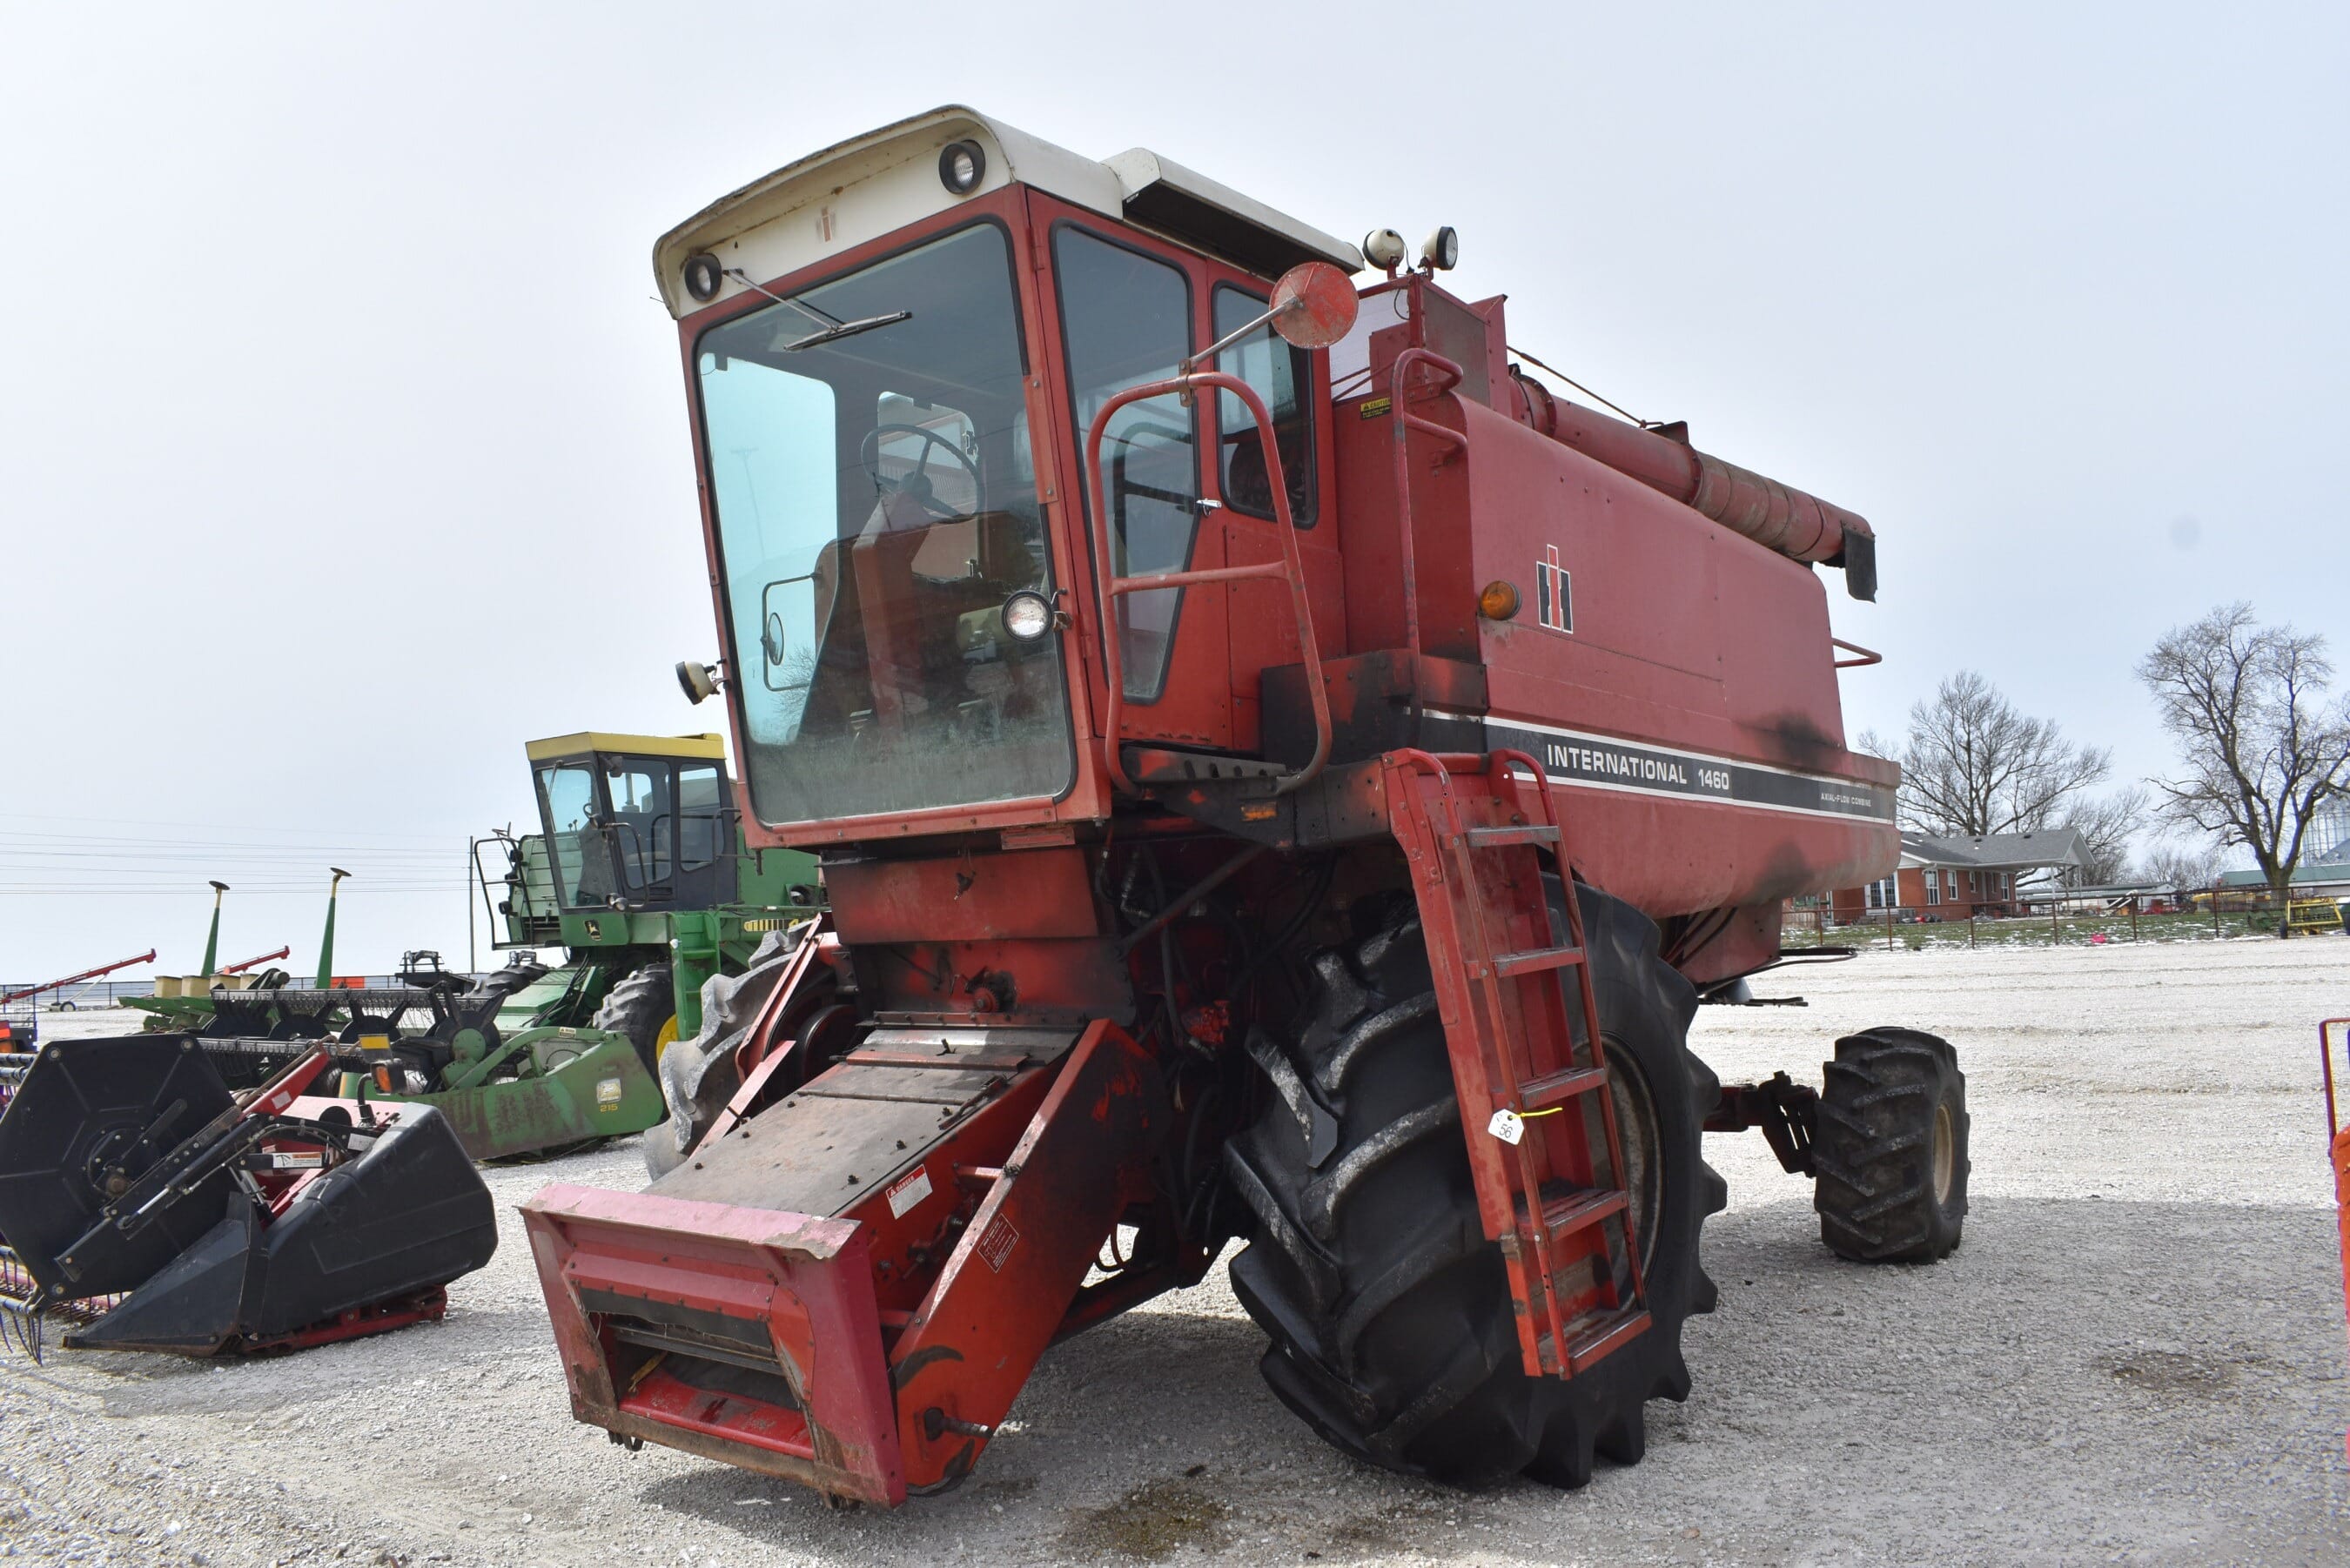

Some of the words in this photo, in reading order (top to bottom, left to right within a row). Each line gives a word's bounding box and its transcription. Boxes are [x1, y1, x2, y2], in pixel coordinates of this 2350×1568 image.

[1548, 744, 1687, 784] INTERNATIONAL
[1698, 768, 1729, 790] 1460
[601, 1103, 618, 1113] 215
[1499, 1122, 1513, 1139] 56
